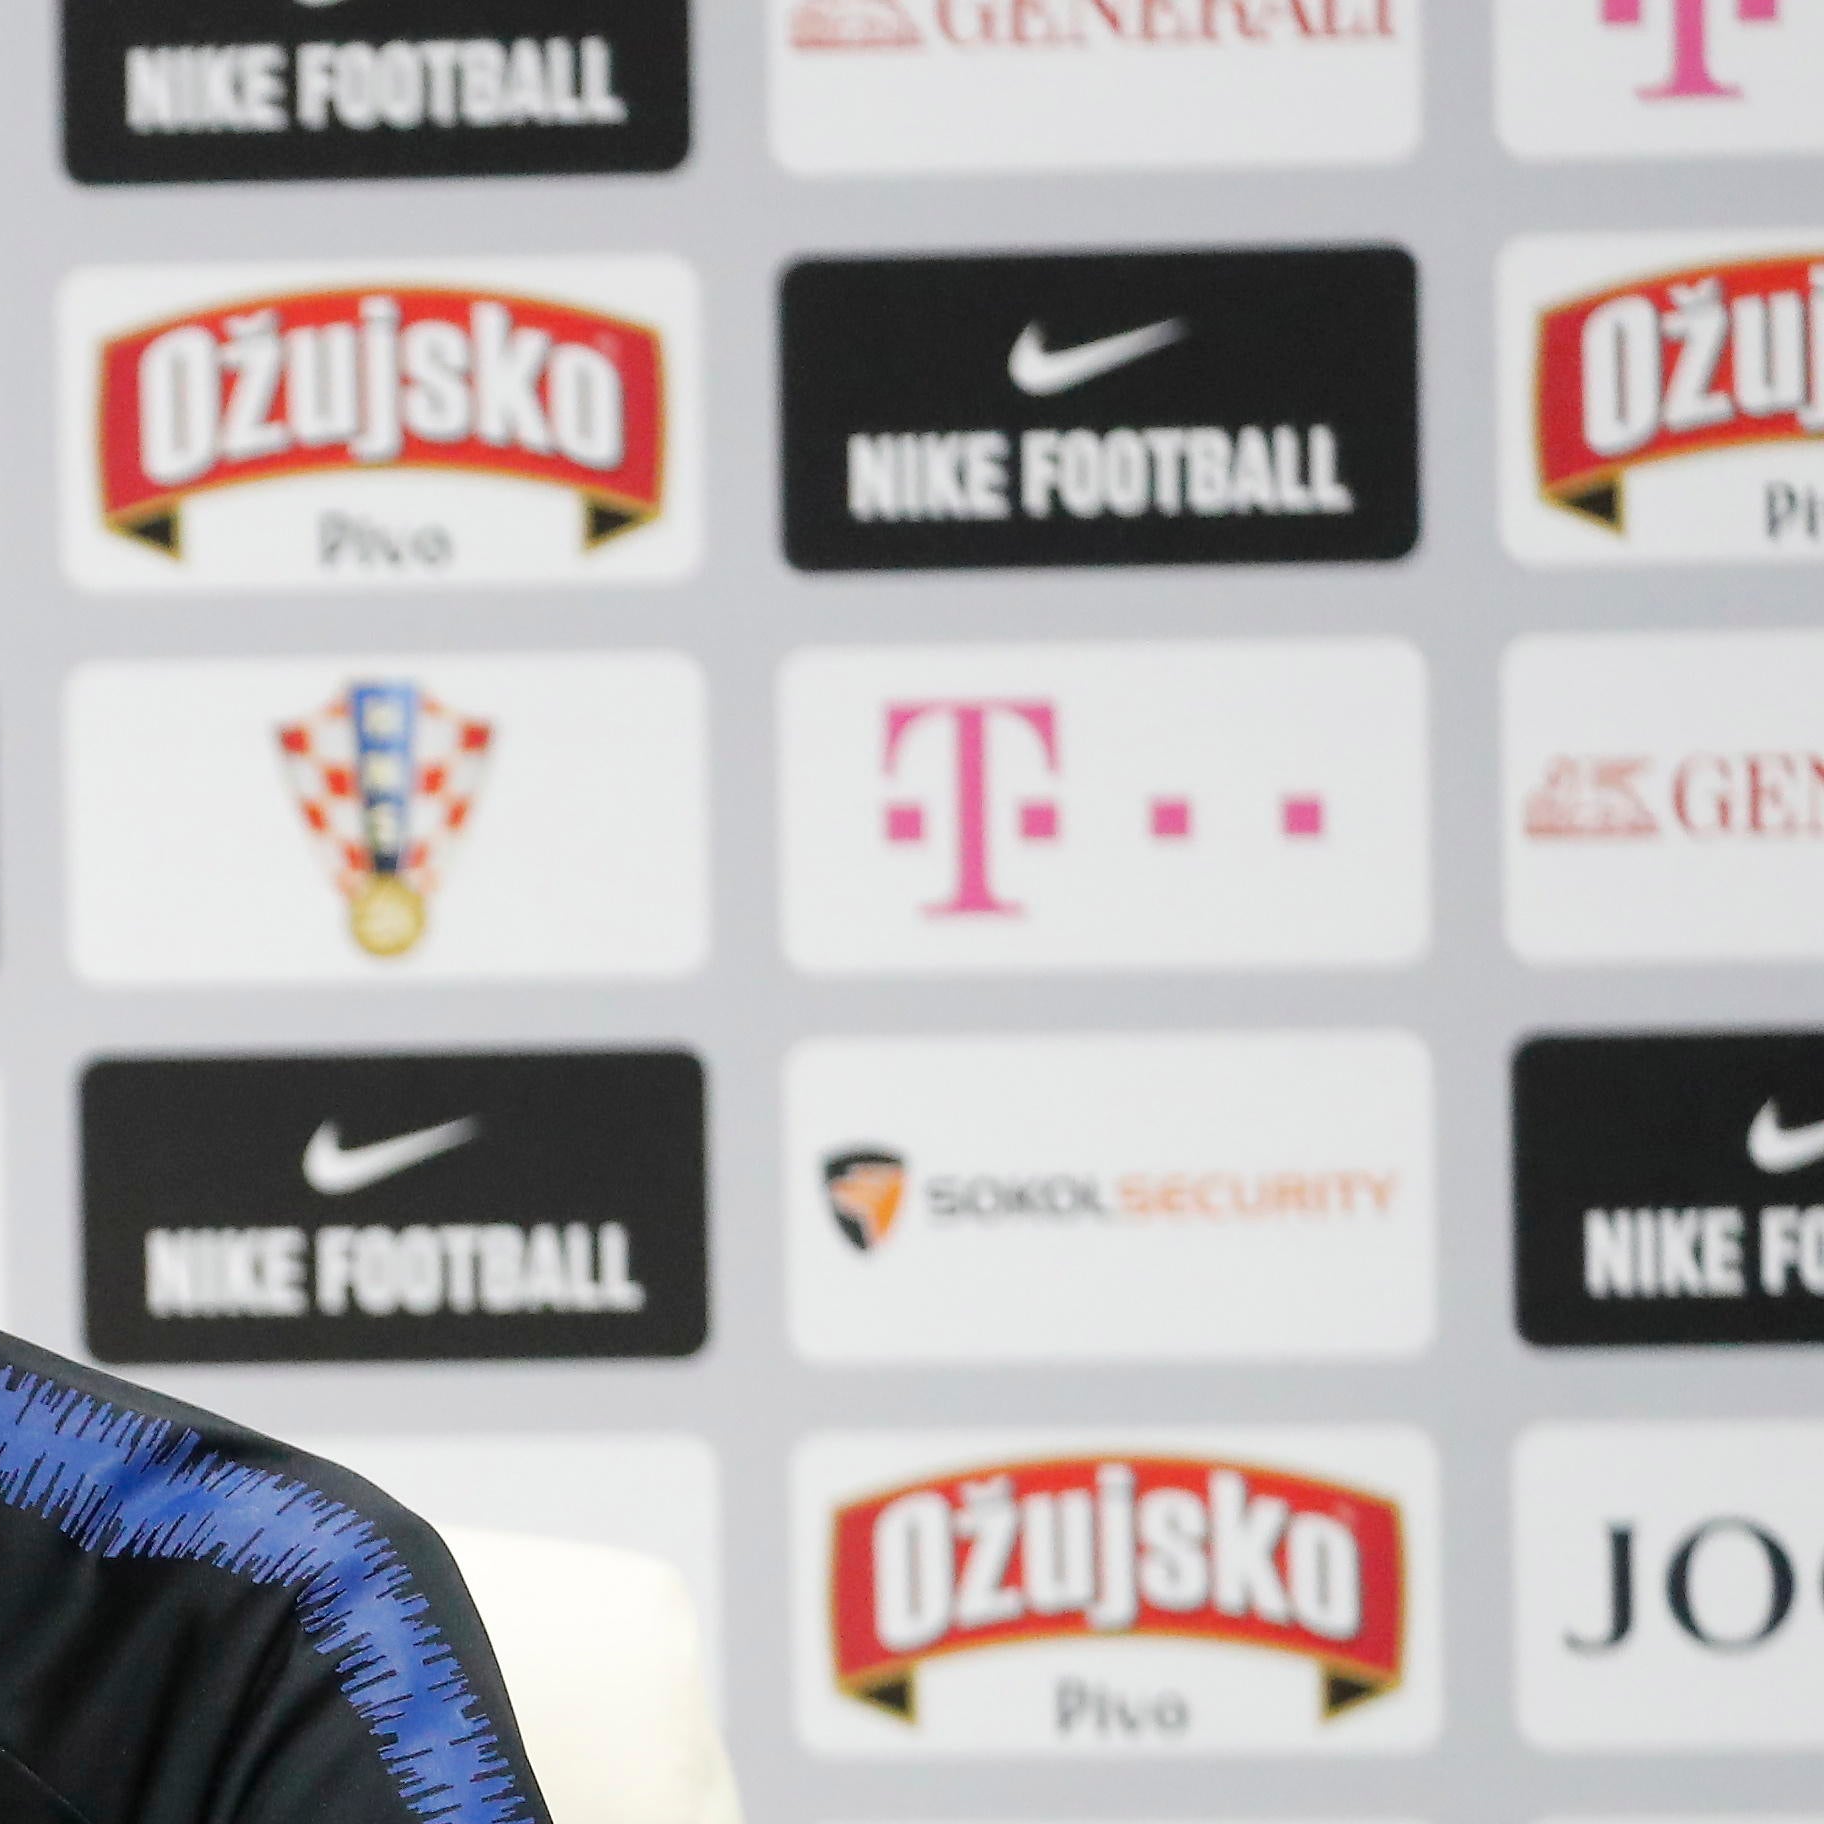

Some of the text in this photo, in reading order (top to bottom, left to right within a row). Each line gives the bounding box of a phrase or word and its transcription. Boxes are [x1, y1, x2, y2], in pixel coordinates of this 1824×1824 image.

[123, 35, 629, 136] NIKE FOOTBALL
[139, 295, 625, 487] Ožujsko
[845, 422, 1354, 524] NIKE FOOTBALL
[142, 1219, 647, 1321] NIKE FOOTBALL
[1581, 1204, 1746, 1300] NIKE
[873, 1462, 1362, 1653] Ožujsko
